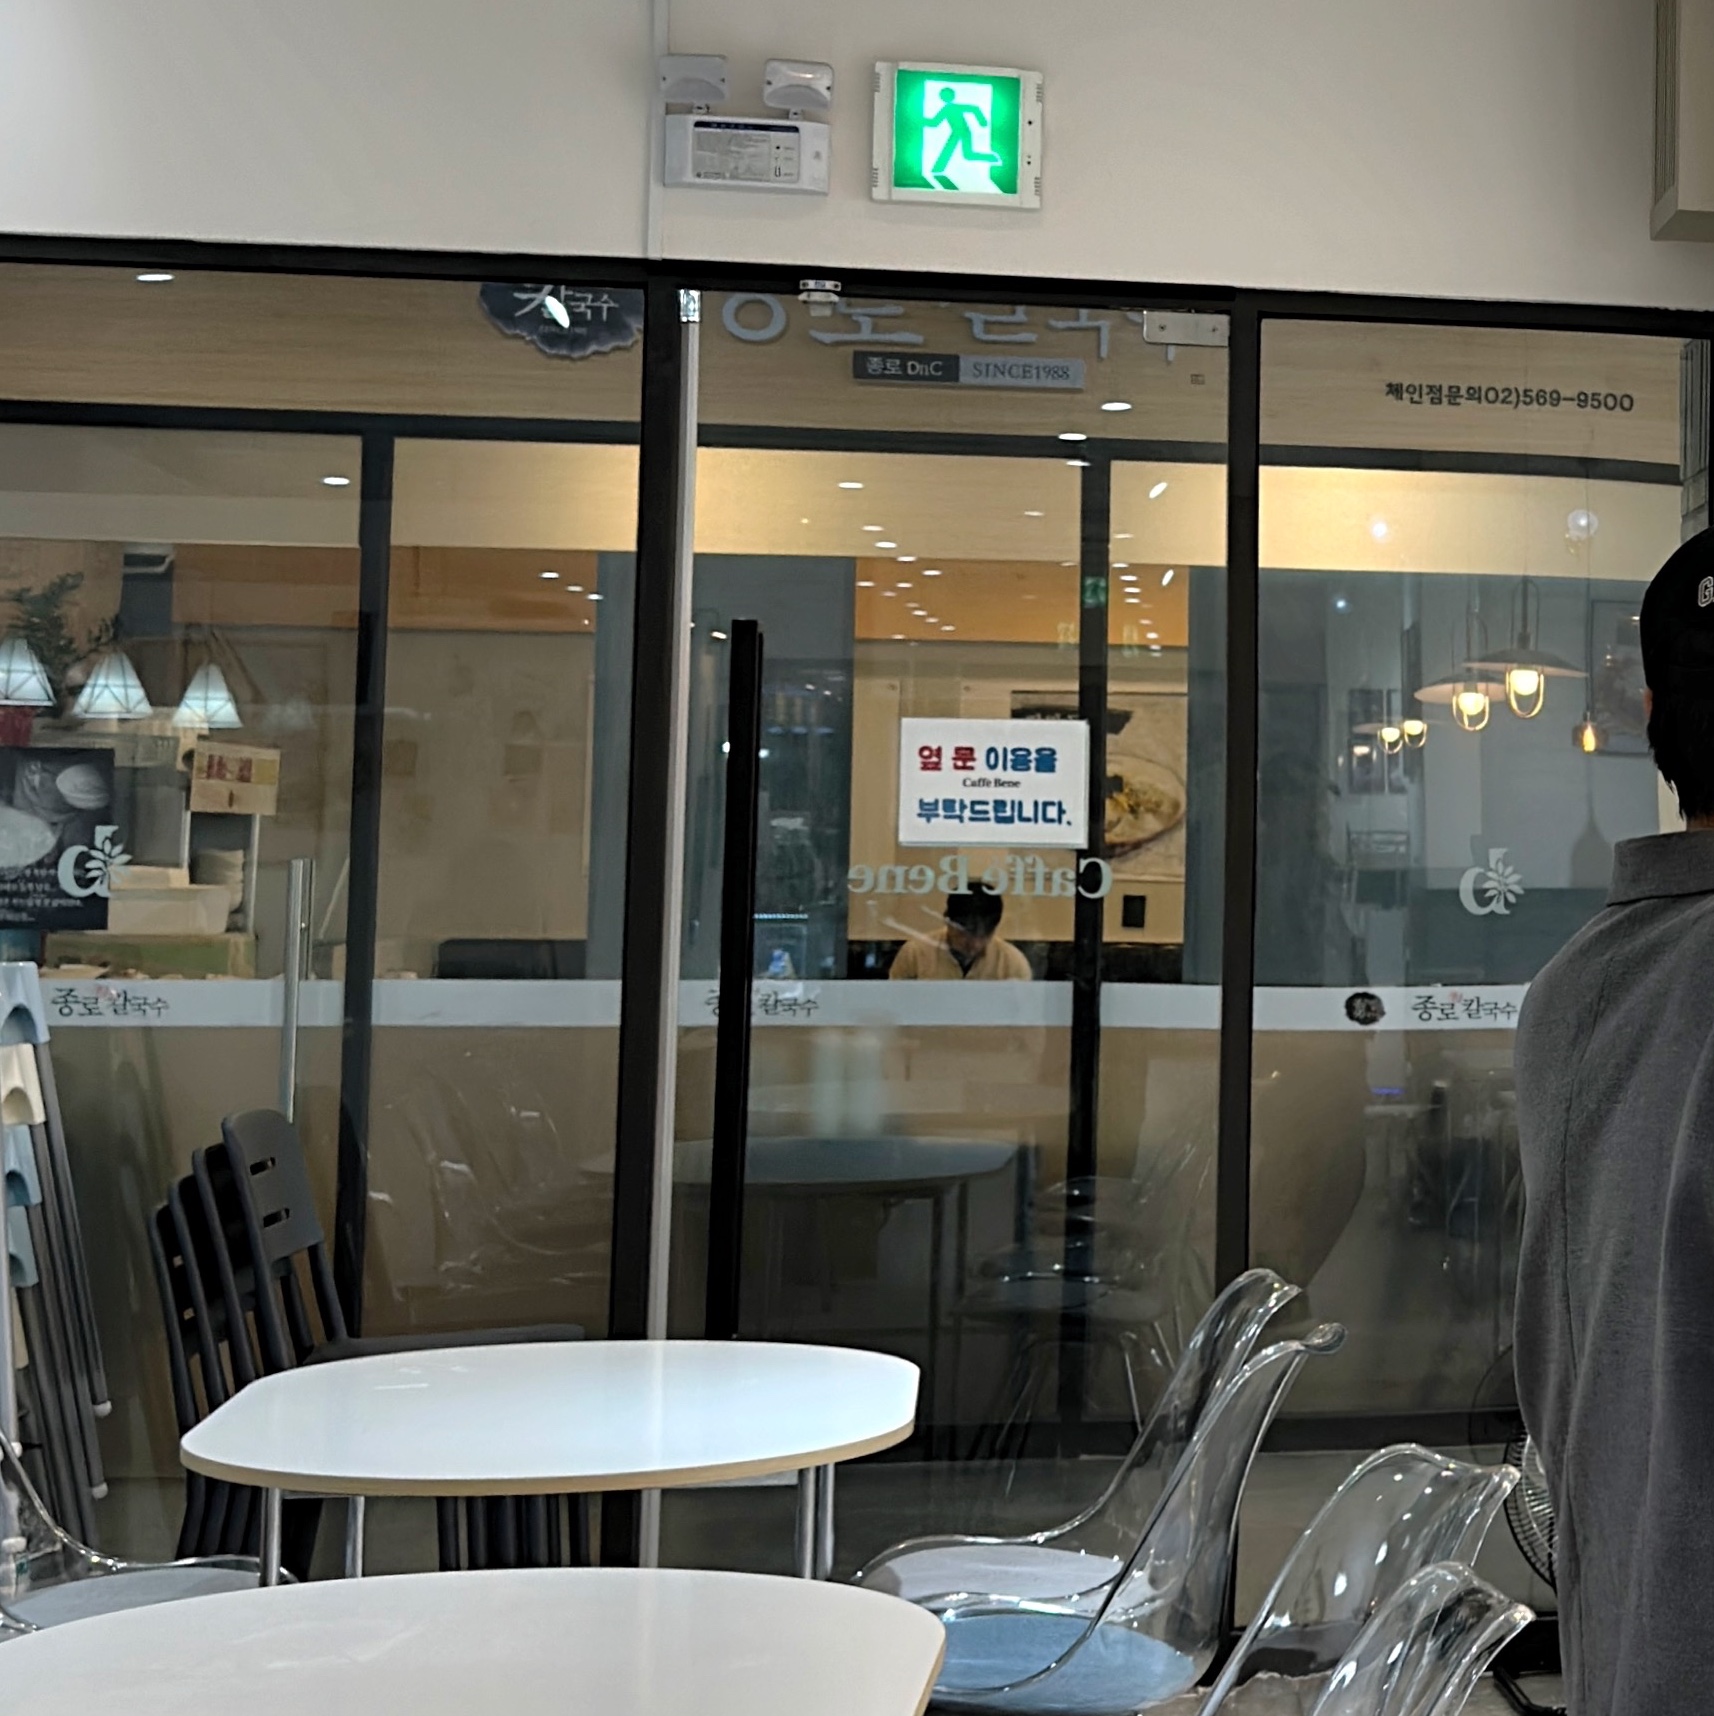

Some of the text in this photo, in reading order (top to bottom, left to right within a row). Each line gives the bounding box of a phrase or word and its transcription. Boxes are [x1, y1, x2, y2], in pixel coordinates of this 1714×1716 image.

[866, 356, 943, 377] 종로 DnC
[952, 746, 977, 771] 문
[985, 746, 1058, 774] 이용을
[994, 777, 1022, 788] Bene
[917, 798, 1072, 826] 부탁드립니다.
[1411, 994, 1460, 1021] 종로
[1462, 995, 1518, 1021] 칼국수
